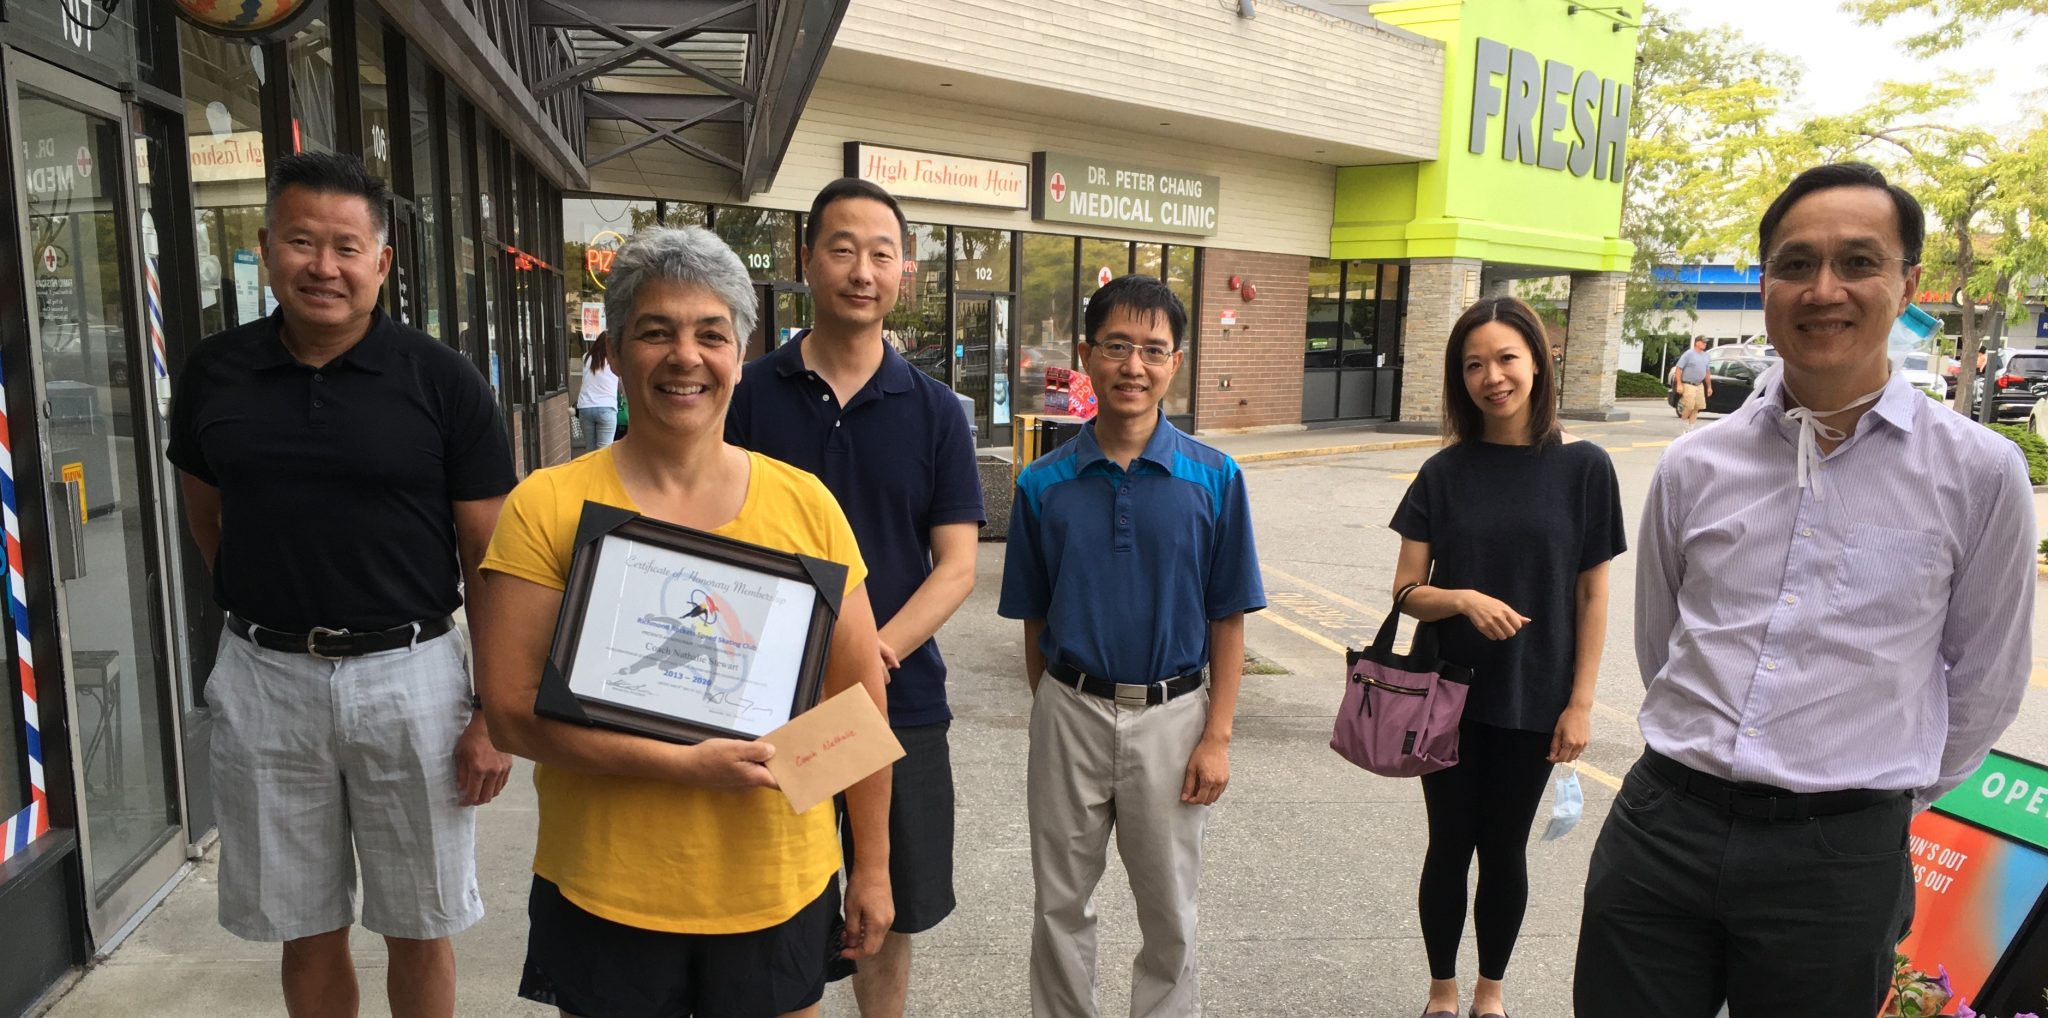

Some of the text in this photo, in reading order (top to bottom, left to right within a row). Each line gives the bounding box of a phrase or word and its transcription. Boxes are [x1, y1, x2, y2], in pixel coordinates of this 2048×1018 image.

[1468, 36, 1632, 183] FRESH
[371, 124, 387, 162] 106
[865, 154, 1022, 196] High Fashion Hair
[1088, 165, 1203, 198] DR. PETER CHANG
[1069, 190, 1216, 230] MEDICAL CLINIC
[747, 253, 771, 269] 103
[975, 267, 993, 281] 102
[625, 555, 671, 578] Certificate
[672, 567, 685, 580] of
[687, 569, 731, 593] Honorary
[637, 616, 671, 632] Richmond
[718, 636, 741, 649] Skating
[742, 641, 758, 652] Club
[645, 642, 671, 656] Coach
[673, 649, 708, 664] Nathalie
[708, 657, 740, 671] Stewart
[663, 670, 684, 681] 2013
[692, 675, 713, 687] 2020
[1981, 771, 2048, 818] OPE
[1909, 834, 1941, 862] UN'S
[1937, 848, 1969, 873] OUT
[1924, 870, 1954, 894] OUT
